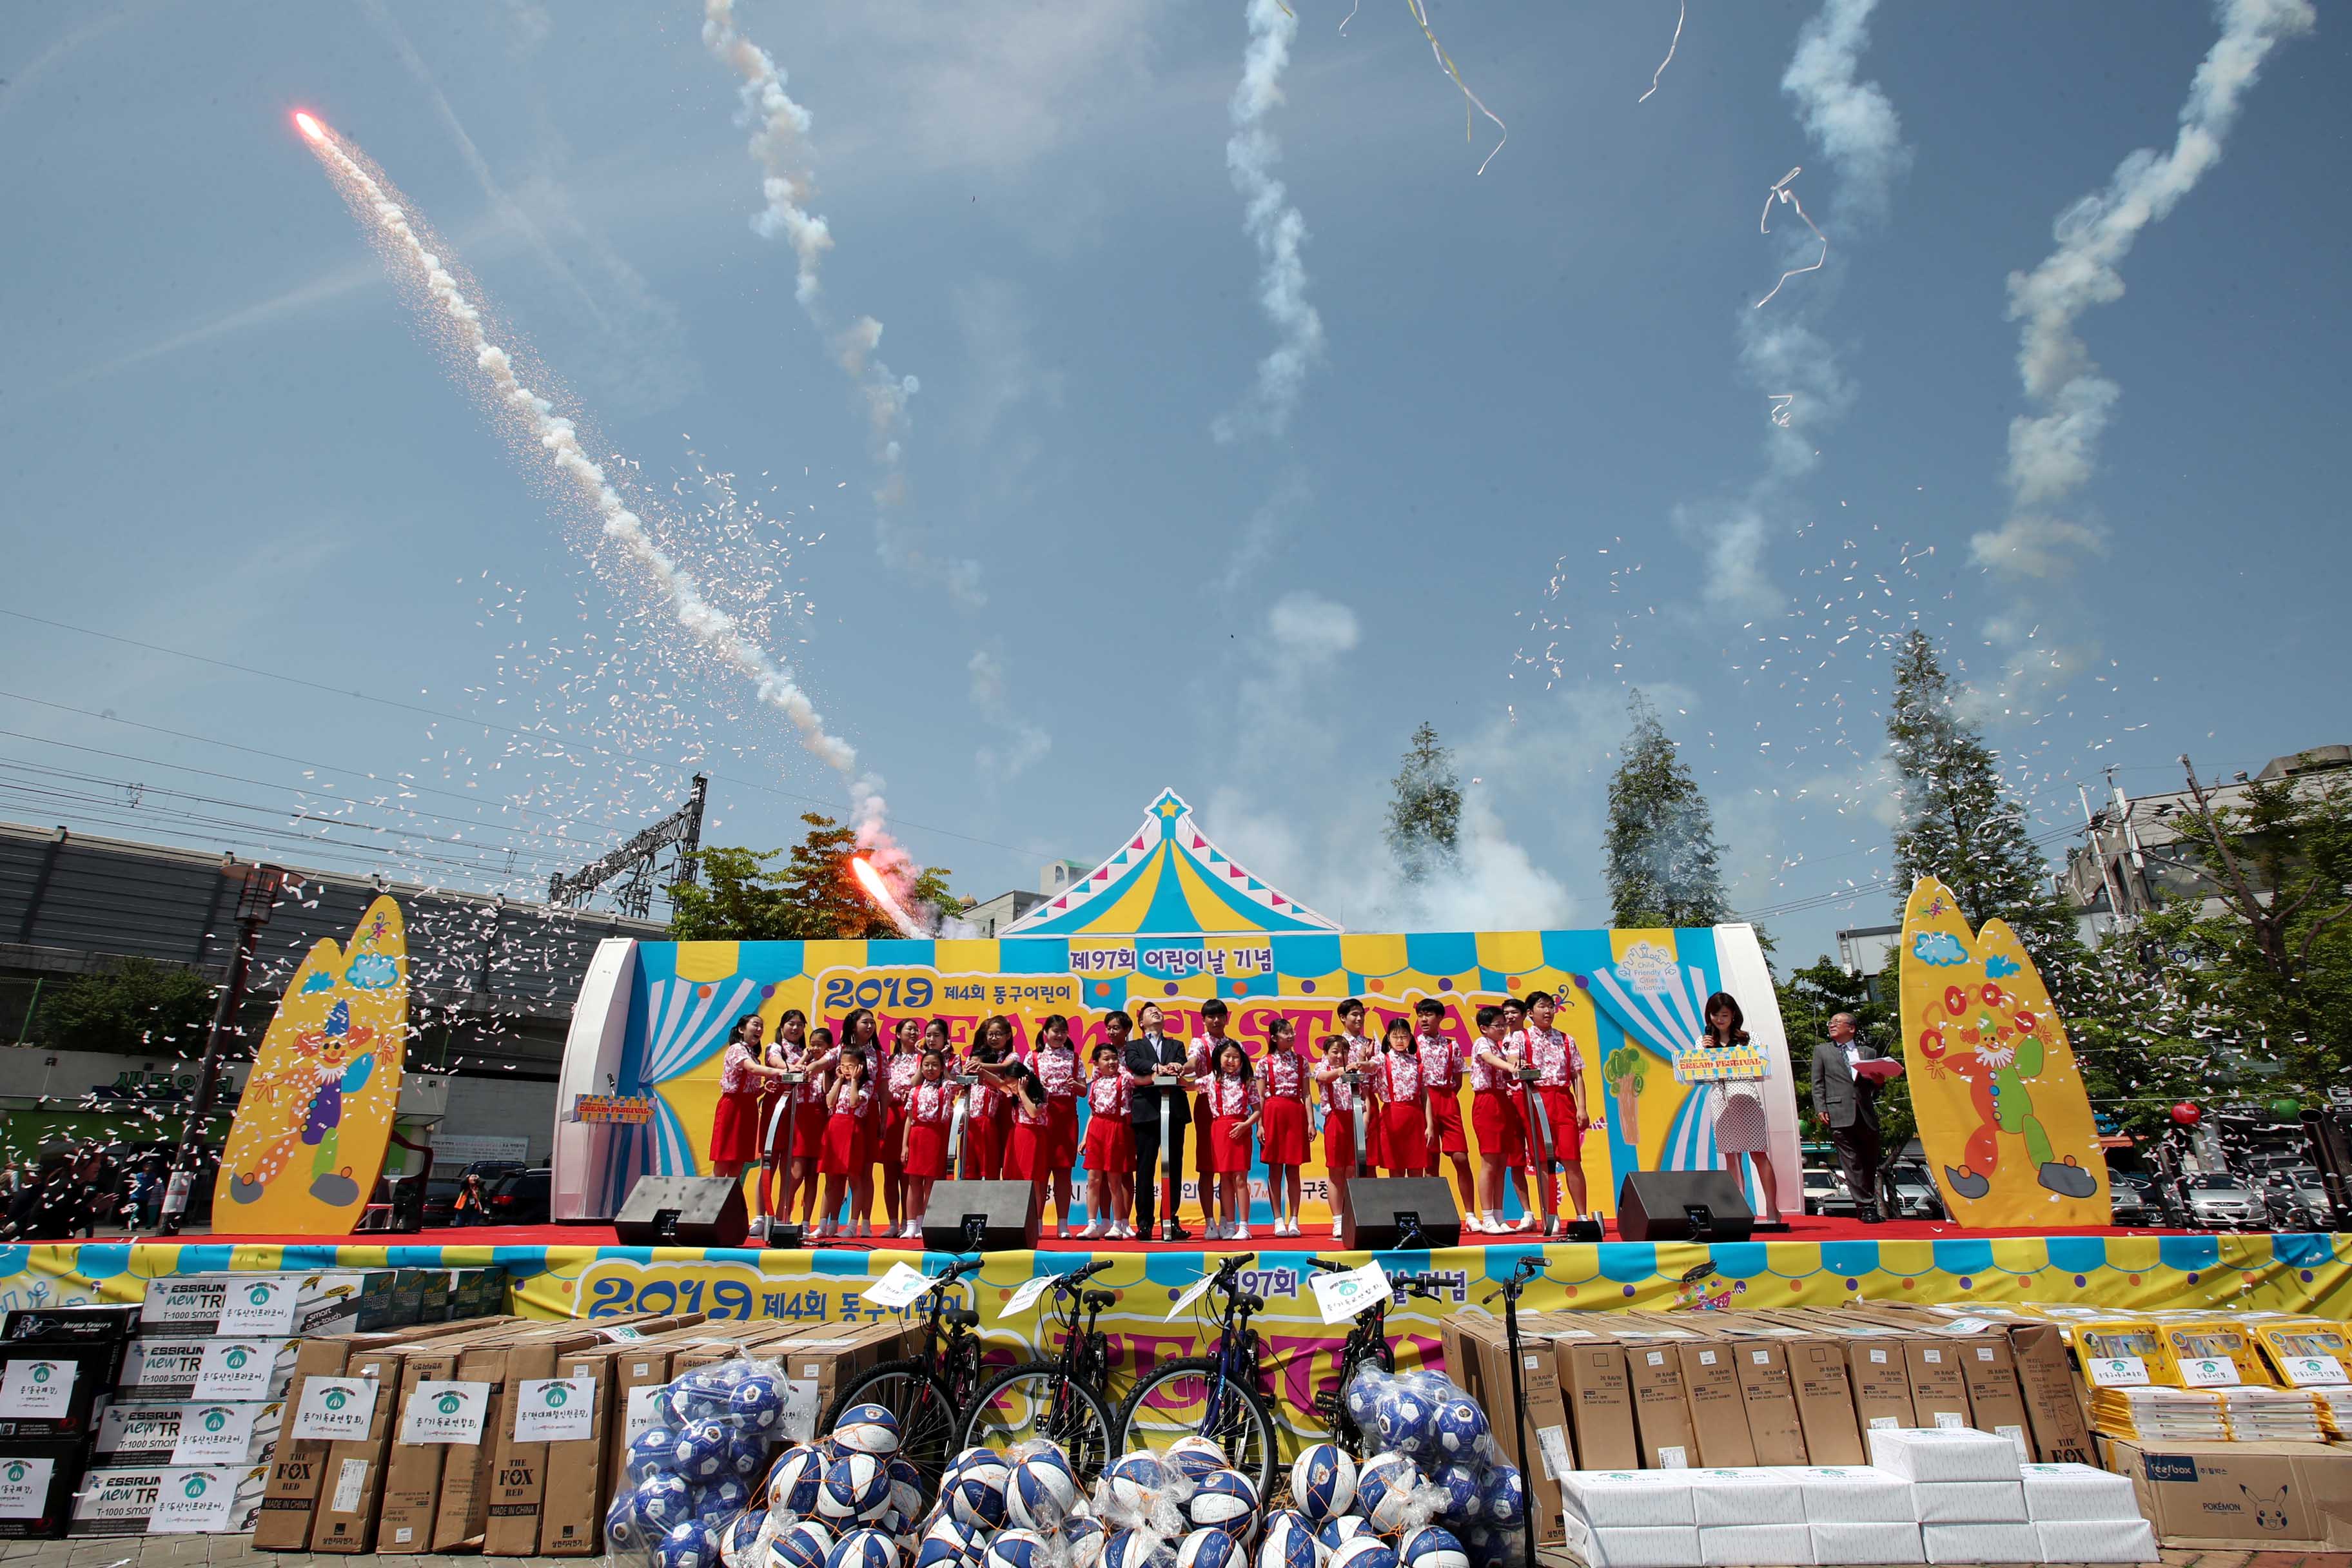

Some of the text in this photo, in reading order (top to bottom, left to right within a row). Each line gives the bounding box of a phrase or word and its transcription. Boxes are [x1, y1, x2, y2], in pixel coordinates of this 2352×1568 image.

[1070, 948, 1272, 974] 제97회 어린이날 기념
[825, 977, 1071, 1009] 2019 제4회 동구어린이
[1716, 1058, 1762, 1068] FESTIVAL
[171, 1284, 226, 1293] ESSRUN
[166, 1295, 198, 1306] new
[588, 1277, 752, 1320] 2019
[763, 1291, 827, 1320] 제4회
[191, 1310, 220, 1319] smart
[308, 1308, 332, 1321] smart
[305, 1313, 341, 1329] one-touch
[151, 1346, 206, 1356] ESSRUN
[146, 1358, 177, 1369] new
[128, 1411, 182, 1420] ESSRUN
[124, 1422, 157, 1434] new
[2057, 1438, 2075, 1447] THE
[2051, 1448, 2089, 1464] FOX
[275, 1463, 313, 1480] FOX
[499, 1469, 534, 1485] FOX
[100, 1488, 133, 1501] new
[505, 1488, 524, 1497] RED
[265, 1500, 309, 1509] MADE IN CHINA
[492, 1505, 535, 1515] MADE IN CHINA
[2203, 1501, 2241, 1511] POKÉMON
[97, 1507, 124, 1516] T-1000
